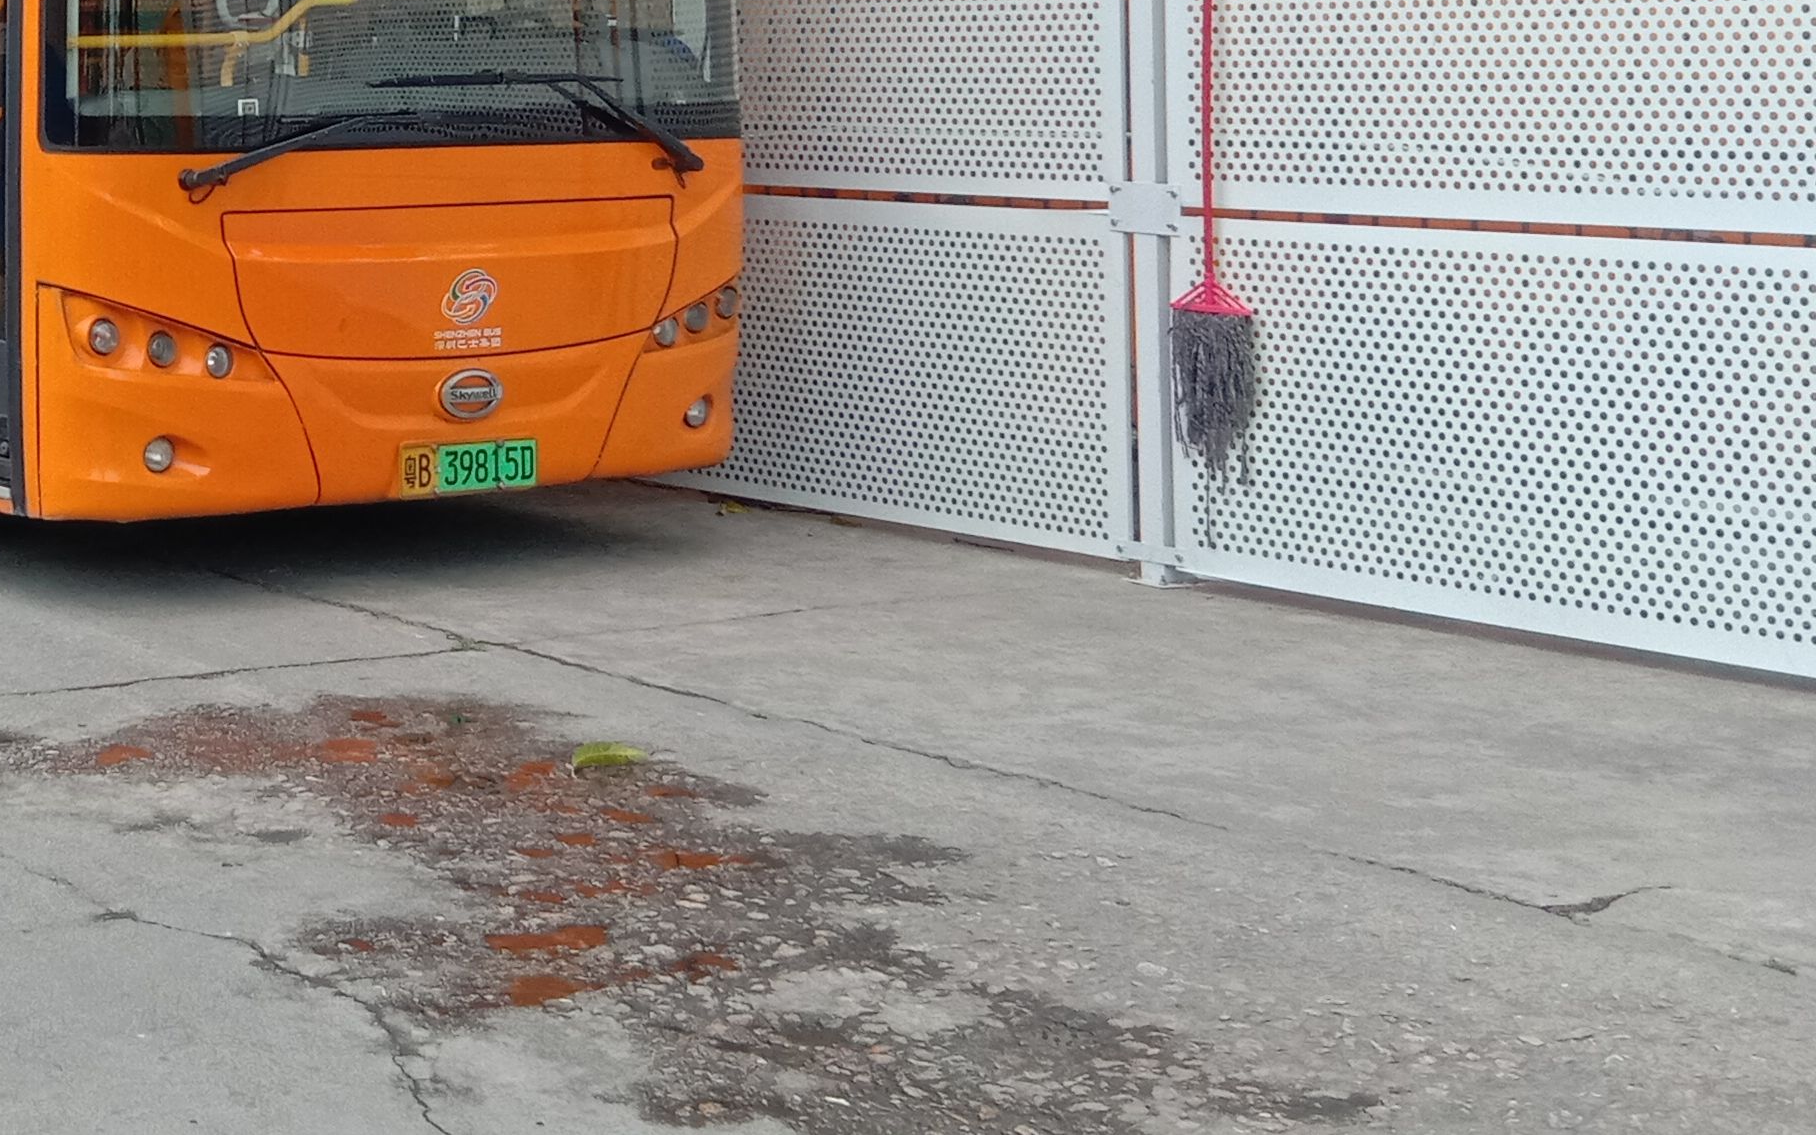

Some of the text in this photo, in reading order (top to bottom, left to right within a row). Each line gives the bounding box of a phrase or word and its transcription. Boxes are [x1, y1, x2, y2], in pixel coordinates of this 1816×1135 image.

[433, 327, 502, 339] SHENZHEN BUS
[450, 388, 498, 401] Skywell
[444, 445, 534, 486] 39815D
